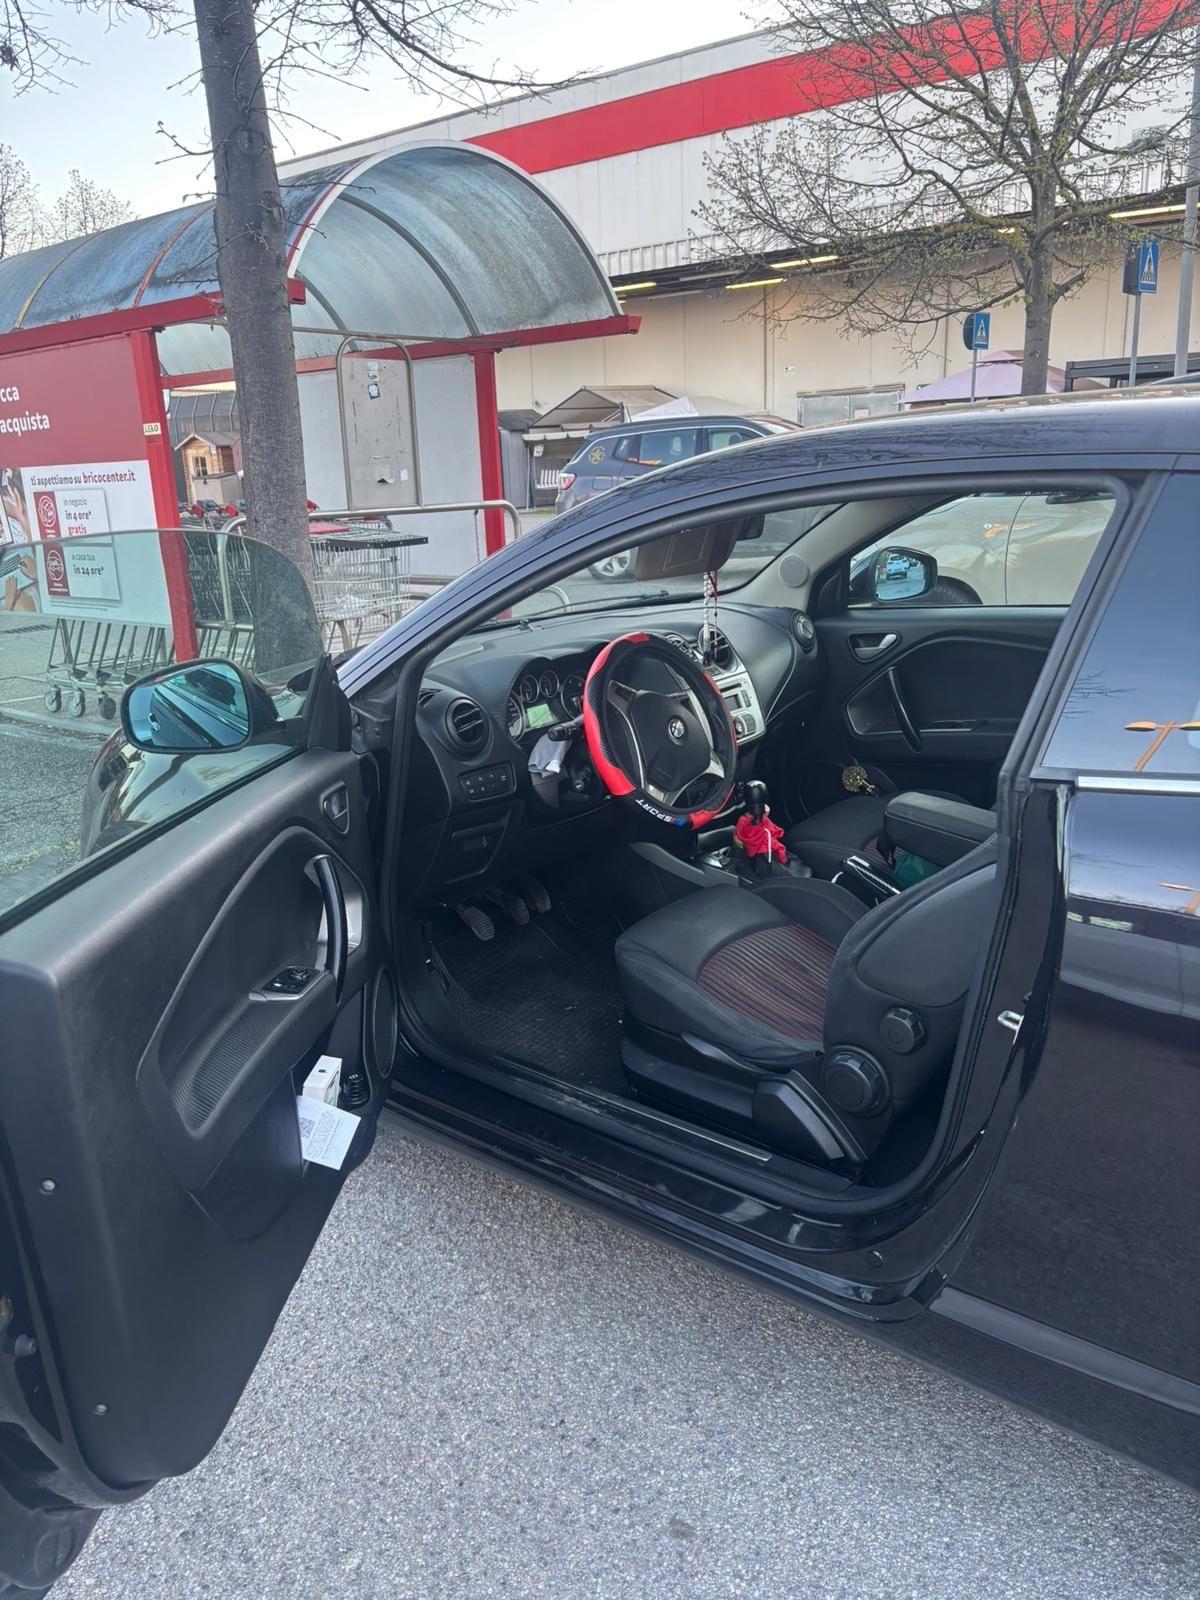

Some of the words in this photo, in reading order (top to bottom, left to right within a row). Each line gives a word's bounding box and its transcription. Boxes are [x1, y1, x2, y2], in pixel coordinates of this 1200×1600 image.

[0, 410, 51, 437] acquista
[37, 474, 74, 488] aspettiamo
[74, 476, 82, 484] su
[82, 469, 136, 484] bricocenter.it
[65, 510, 73, 520] in
[67, 524, 87, 536] gratis
[73, 564, 80, 574] in
[81, 566, 89, 576] 24
[635, 799, 673, 823] SPORT
